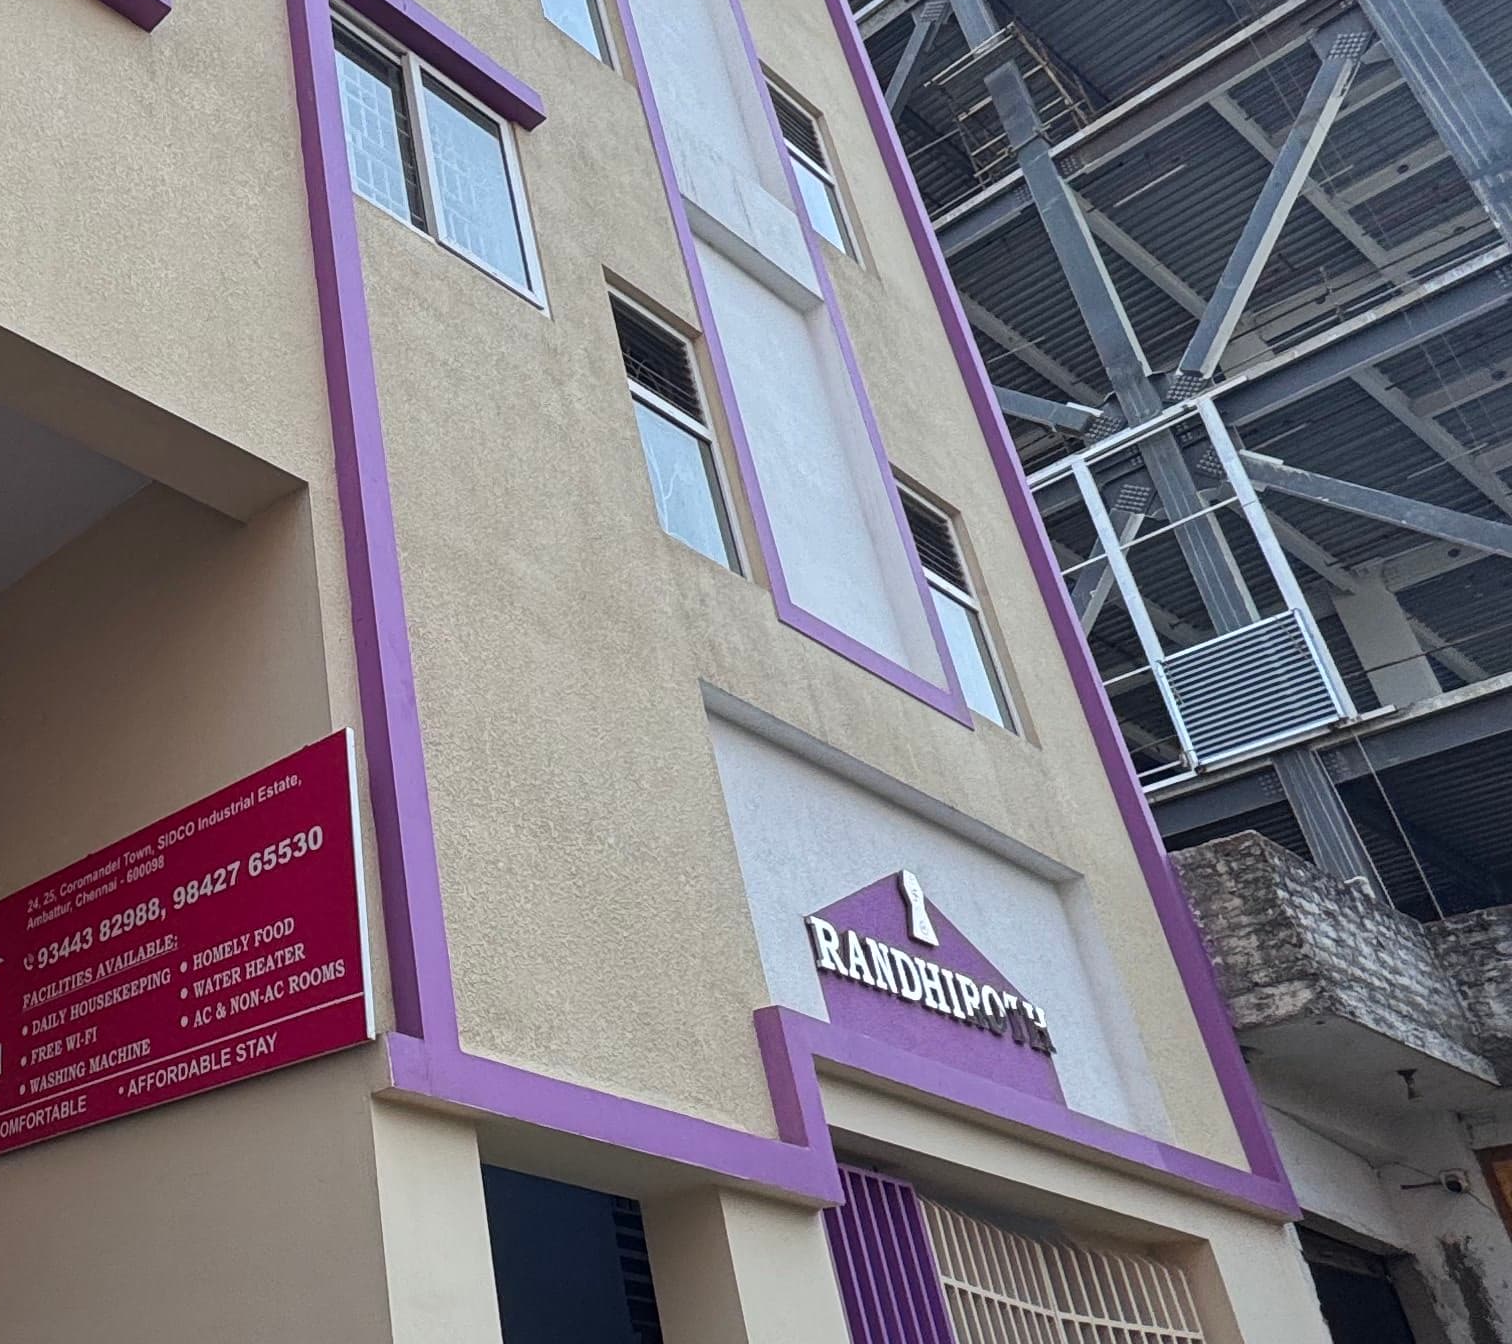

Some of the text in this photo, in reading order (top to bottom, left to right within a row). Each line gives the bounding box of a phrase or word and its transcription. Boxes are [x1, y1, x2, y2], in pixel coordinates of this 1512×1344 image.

[27, 773, 303, 913] 24, 25, Coromandel Town, SIDCO Industrial Estate,
[26, 903, 73, 931] Ambattur,
[75, 876, 118, 907] Chennai
[126, 854, 165, 883] 600098
[37, 825, 324, 969] 93443 82988, 98427 65530
[22, 933, 179, 1010] FACILITIES AVAILABLE:
[192, 916, 295, 971] HOMELY FOOD
[192, 942, 307, 999] WATER HEATER
[31, 967, 172, 1036] DAILY HOUSEKEEPING
[192, 958, 347, 1029] AC & NON-AC ROOMS
[28, 1037, 152, 1096] WASHING MACHINE
[29, 1025, 99, 1067] FREE WI-FI
[127, 1047, 233, 1099] AFFORDABLE
[234, 1031, 279, 1064] STAY
